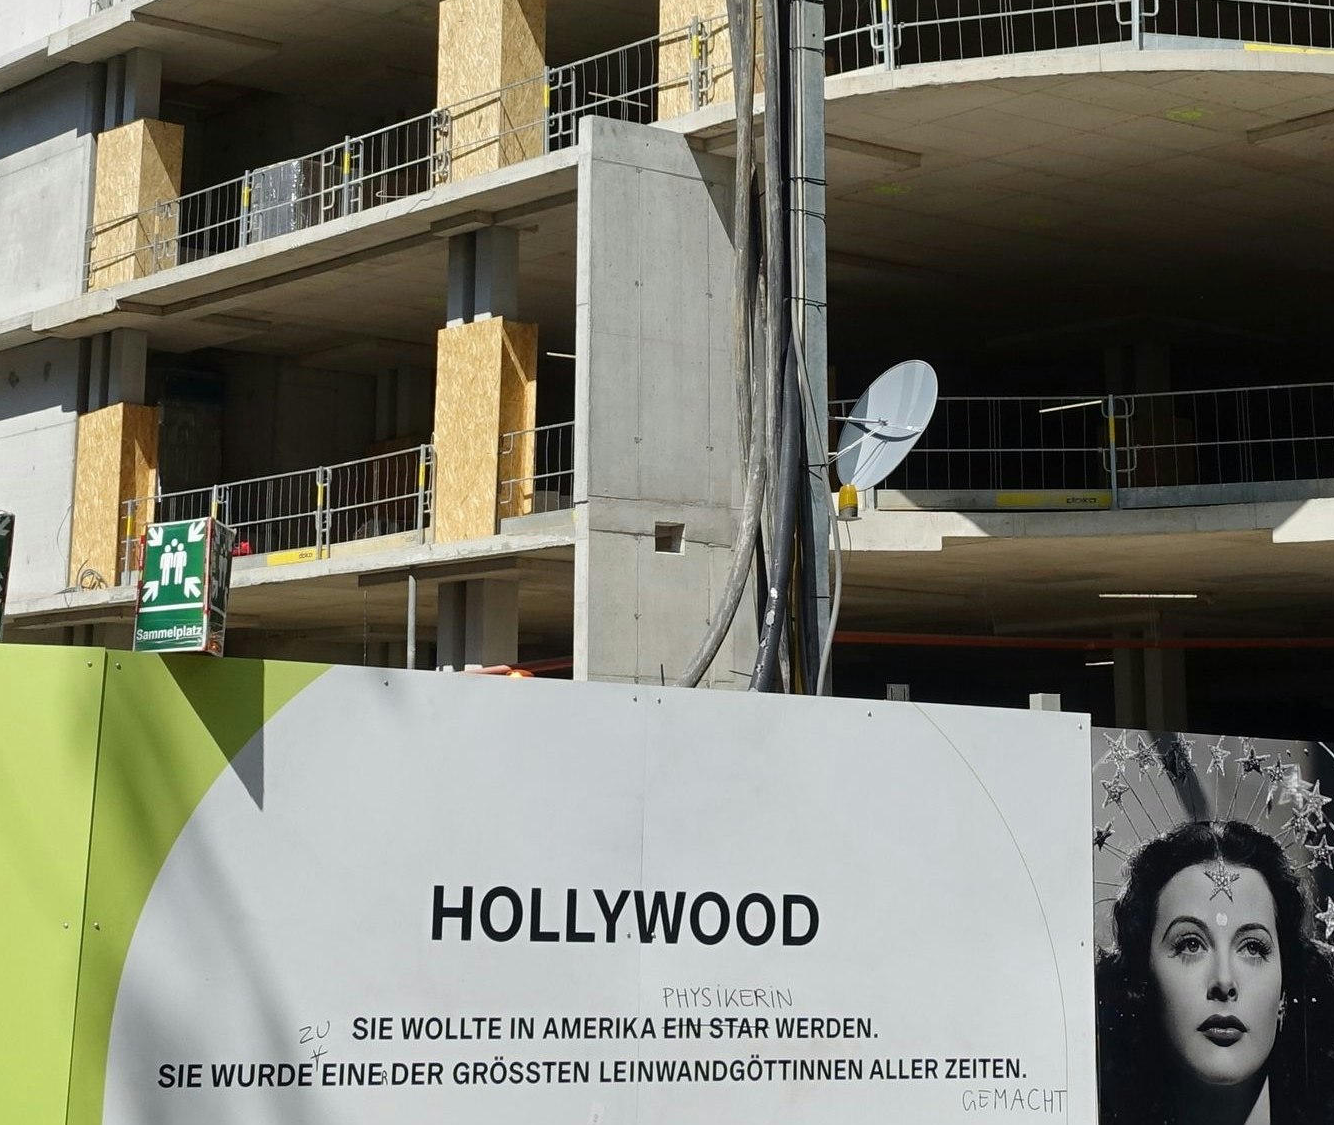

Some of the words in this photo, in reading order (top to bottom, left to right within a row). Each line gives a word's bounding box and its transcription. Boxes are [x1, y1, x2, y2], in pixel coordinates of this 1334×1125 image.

[136, 625, 203, 640] Sammelplatz
[431, 884, 820, 947] HOLLYWOOD
[298, 1020, 331, 1045] ZU
[352, 1016, 394, 1040] SIE
[401, 1016, 503, 1040] WOLLTE
[509, 1016, 535, 1040] IN
[542, 1016, 657, 1040] AMERIKA
[663, 1016, 701, 1039] EIN
[708, 1016, 769, 1039] STAR
[775, 1017, 879, 1039] WERDEN.
[157, 1063, 203, 1088] SIE
[211, 1063, 314, 1088] WURDE
[322, 1062, 383, 1086] EINE
[391, 1062, 444, 1086] DER
[452, 1056, 590, 1085] GRÖSSTEN
[599, 1054, 864, 1084] LEINWANDGÖTTINNEN
[868, 1058, 939, 1081] ALLER
[944, 1058, 1028, 1080] ZEITEN.
[961, 1088, 1068, 1114] GEMACHT
